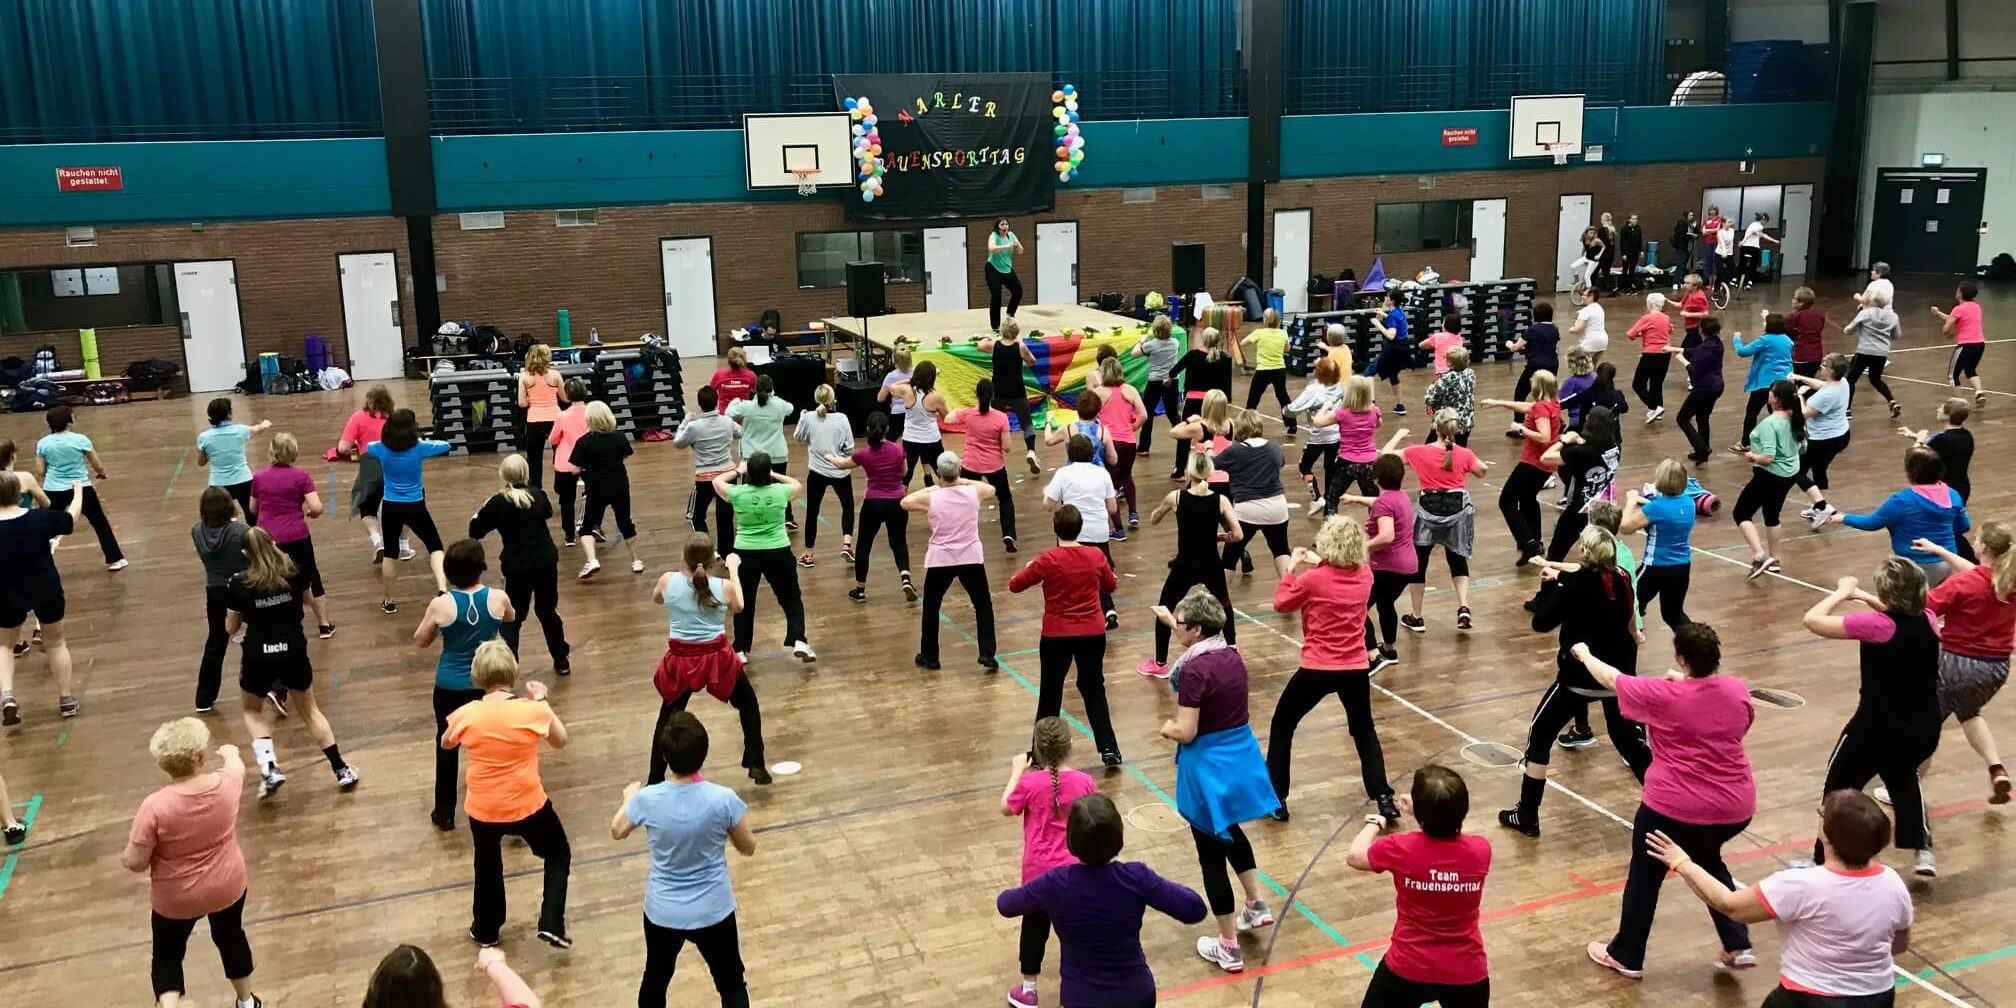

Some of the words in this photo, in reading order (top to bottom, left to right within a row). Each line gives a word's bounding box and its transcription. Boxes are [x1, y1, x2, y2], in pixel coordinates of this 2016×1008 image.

[898, 91, 997, 124] MARLER
[879, 146, 1025, 174] RAUENSPORTTAG
[59, 168, 96, 177] Rauchen
[98, 168, 119, 177] nicht
[1429, 869, 1459, 882] Team
